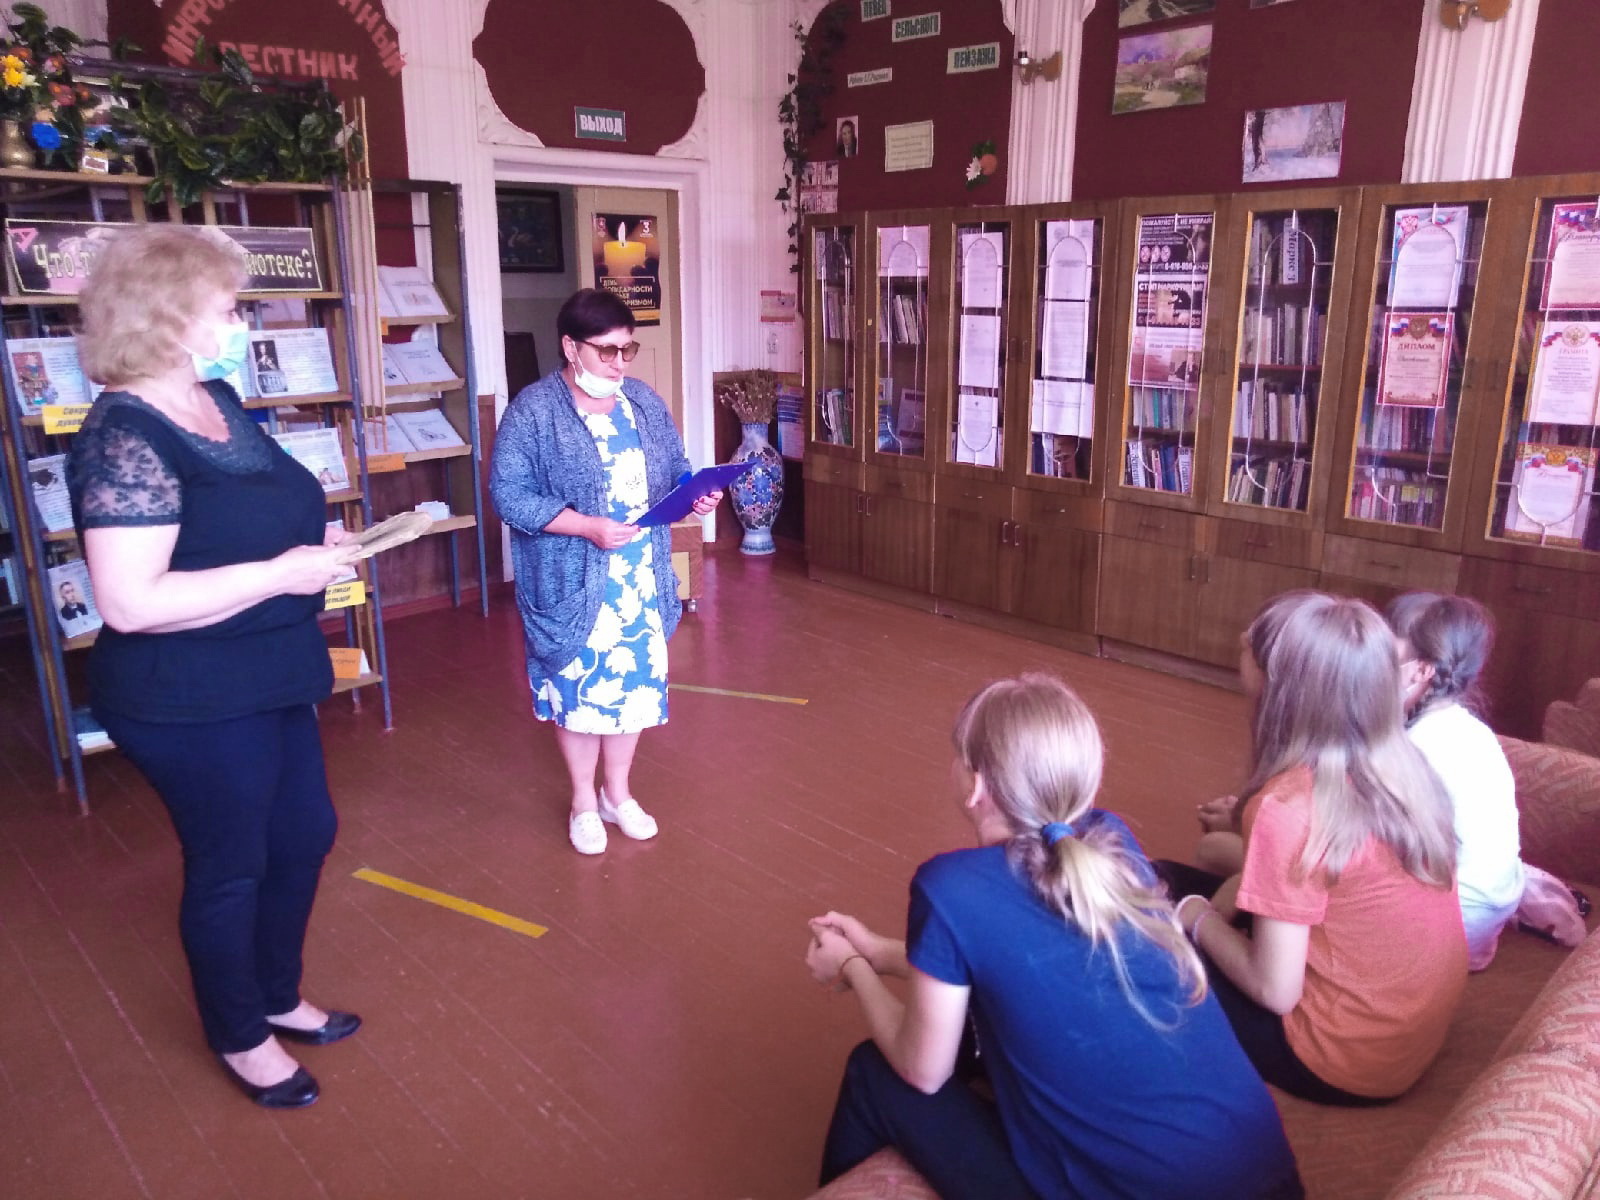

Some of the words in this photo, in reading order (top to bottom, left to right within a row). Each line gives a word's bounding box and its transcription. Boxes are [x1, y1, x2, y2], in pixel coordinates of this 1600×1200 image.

[895, 15, 939, 38] СЕЛЬСКОГО
[953, 47, 996, 69] ПЕЙЗАЖА
[579, 114, 623, 136] ВЫХОД
[642, 221, 650, 233] 3
[33, 244, 75, 278] Что
[243, 248, 313, 278] иотеке?
[603, 285, 653, 293] ОЛИДАРНОСТИ
